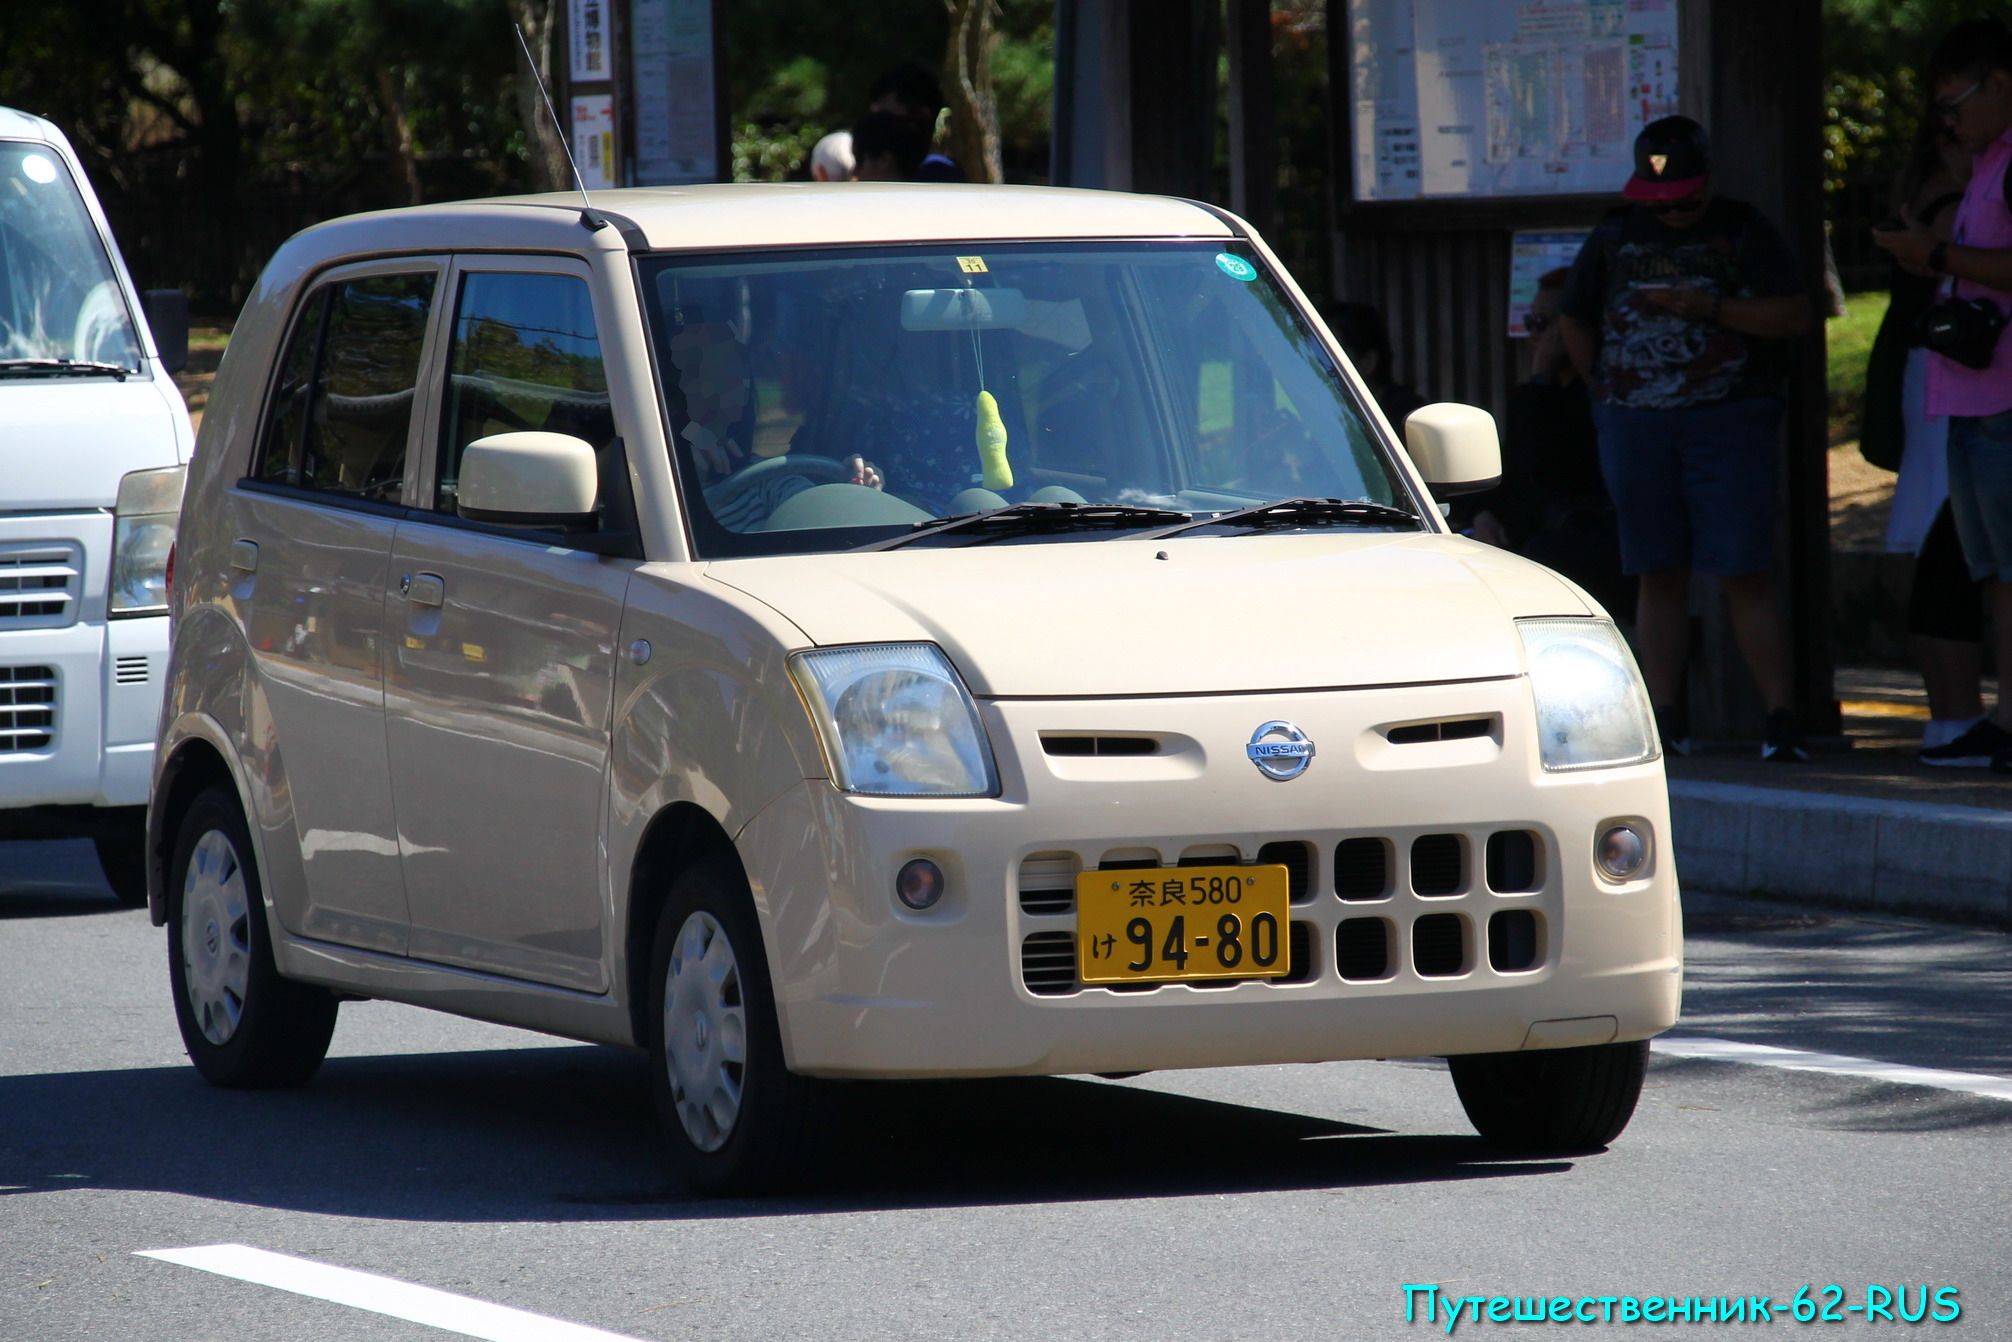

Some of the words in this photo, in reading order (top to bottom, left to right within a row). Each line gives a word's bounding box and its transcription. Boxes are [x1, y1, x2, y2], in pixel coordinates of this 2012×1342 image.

[965, 264, 982, 272] 11
[1092, 933, 1117, 960] け
[1126, 911, 1278, 972] 94-80
